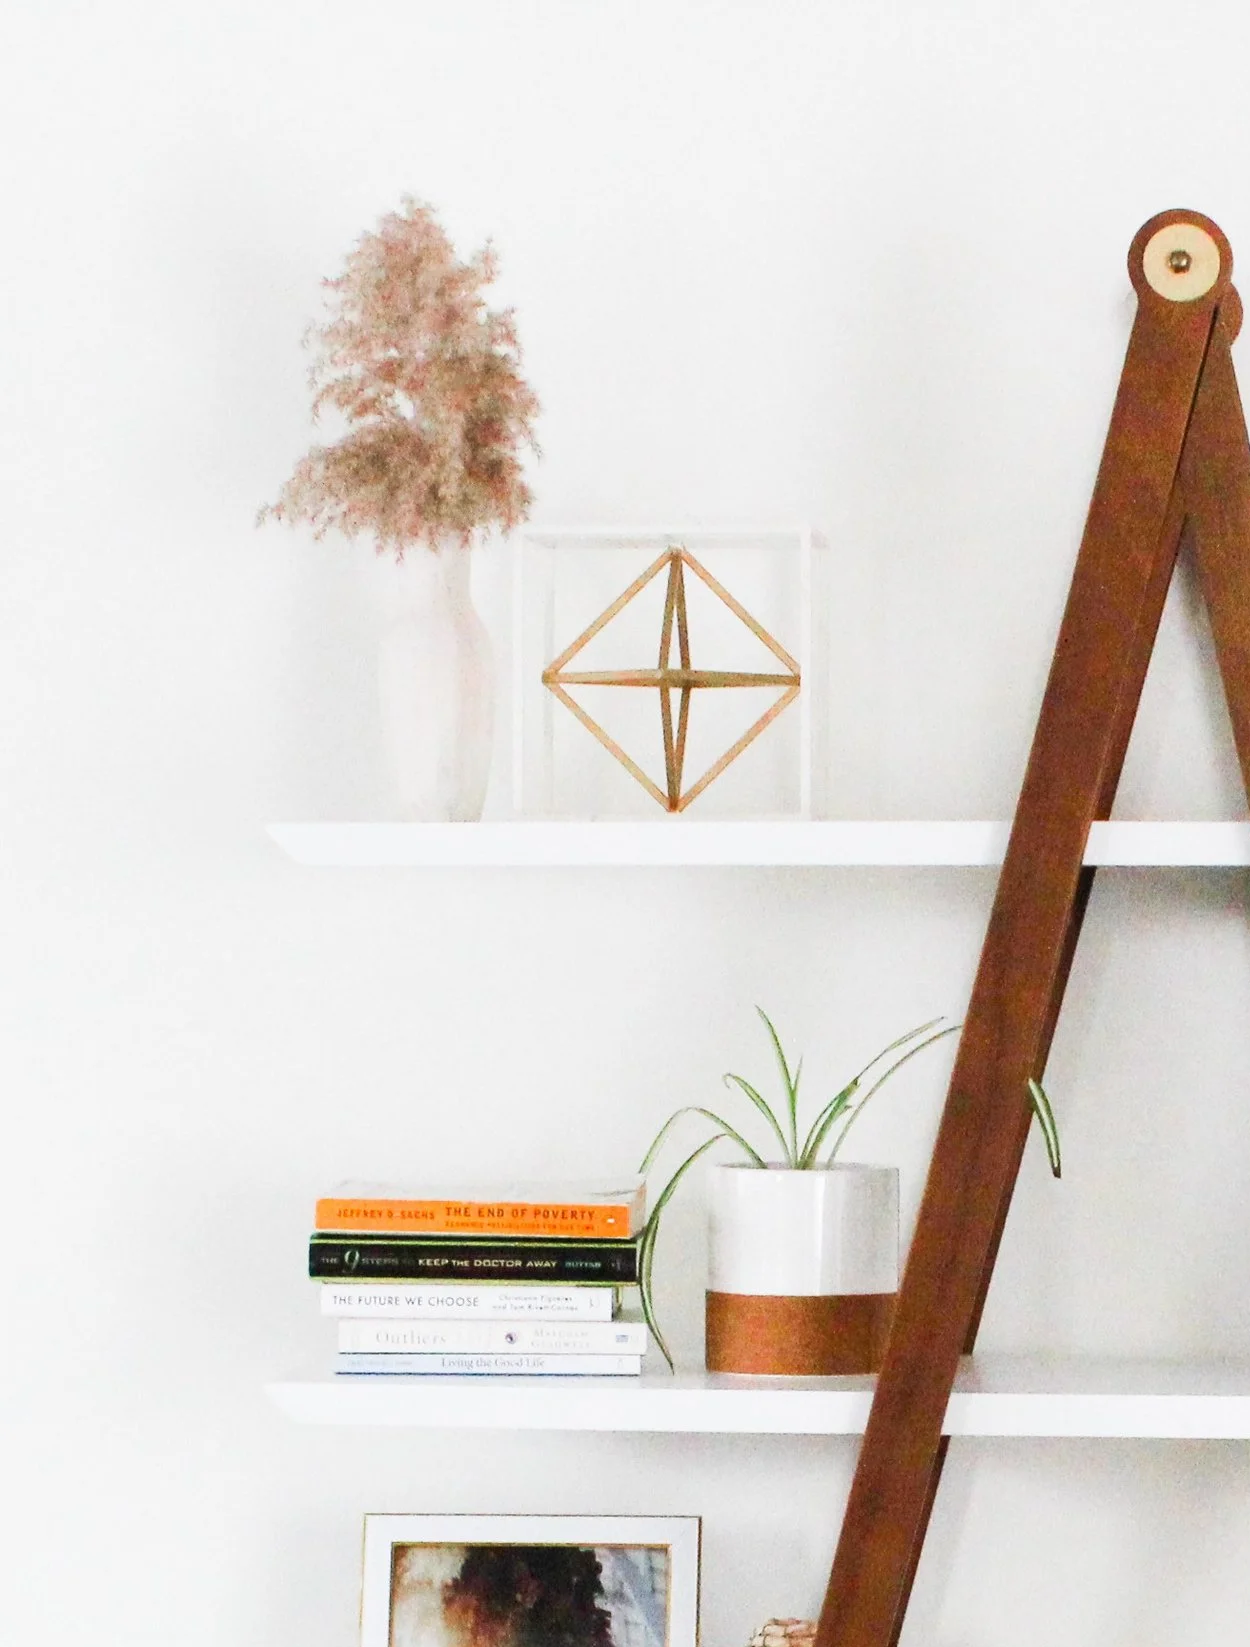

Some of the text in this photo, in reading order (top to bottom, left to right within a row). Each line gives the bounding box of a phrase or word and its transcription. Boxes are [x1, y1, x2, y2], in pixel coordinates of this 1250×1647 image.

[336, 1208, 383, 1219] JEFFREY
[401, 1210, 435, 1220] SACHS
[446, 1206, 471, 1218] THE
[477, 1207, 505, 1218] END
[511, 1208, 528, 1218] OF
[533, 1209, 596, 1220] POVERTY
[344, 1250, 360, 1271] 9
[418, 1258, 449, 1267] KEEP
[473, 1259, 522, 1268] DOCTOR
[526, 1260, 558, 1268] AWAY
[333, 1295, 352, 1305] THE
[358, 1296, 400, 1306] FUTURE
[405, 1296, 423, 1306] WE
[428, 1296, 479, 1307] CHOOSE
[376, 1330, 447, 1345] Outliers
[442, 1356, 545, 1369] Living the Good Life
